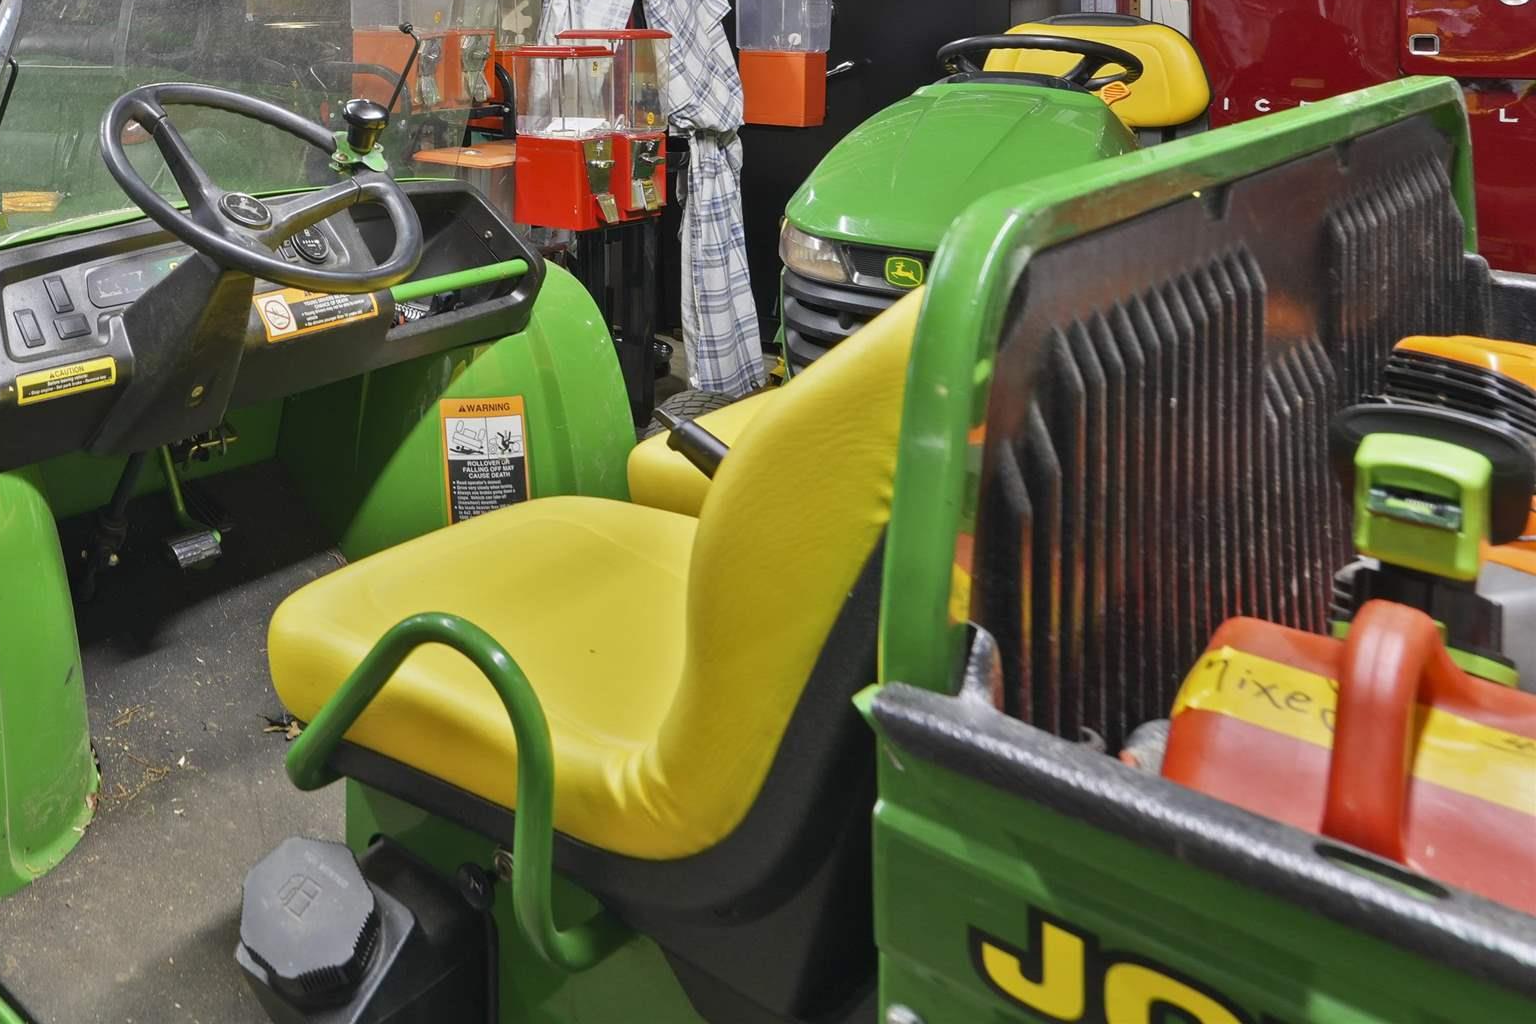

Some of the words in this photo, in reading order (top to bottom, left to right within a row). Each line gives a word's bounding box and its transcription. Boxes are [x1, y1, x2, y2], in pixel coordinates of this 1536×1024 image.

[54, 366, 85, 376] CAUTION
[466, 403, 511, 412] WARNING
[467, 459, 500, 467] ROLLOVER
